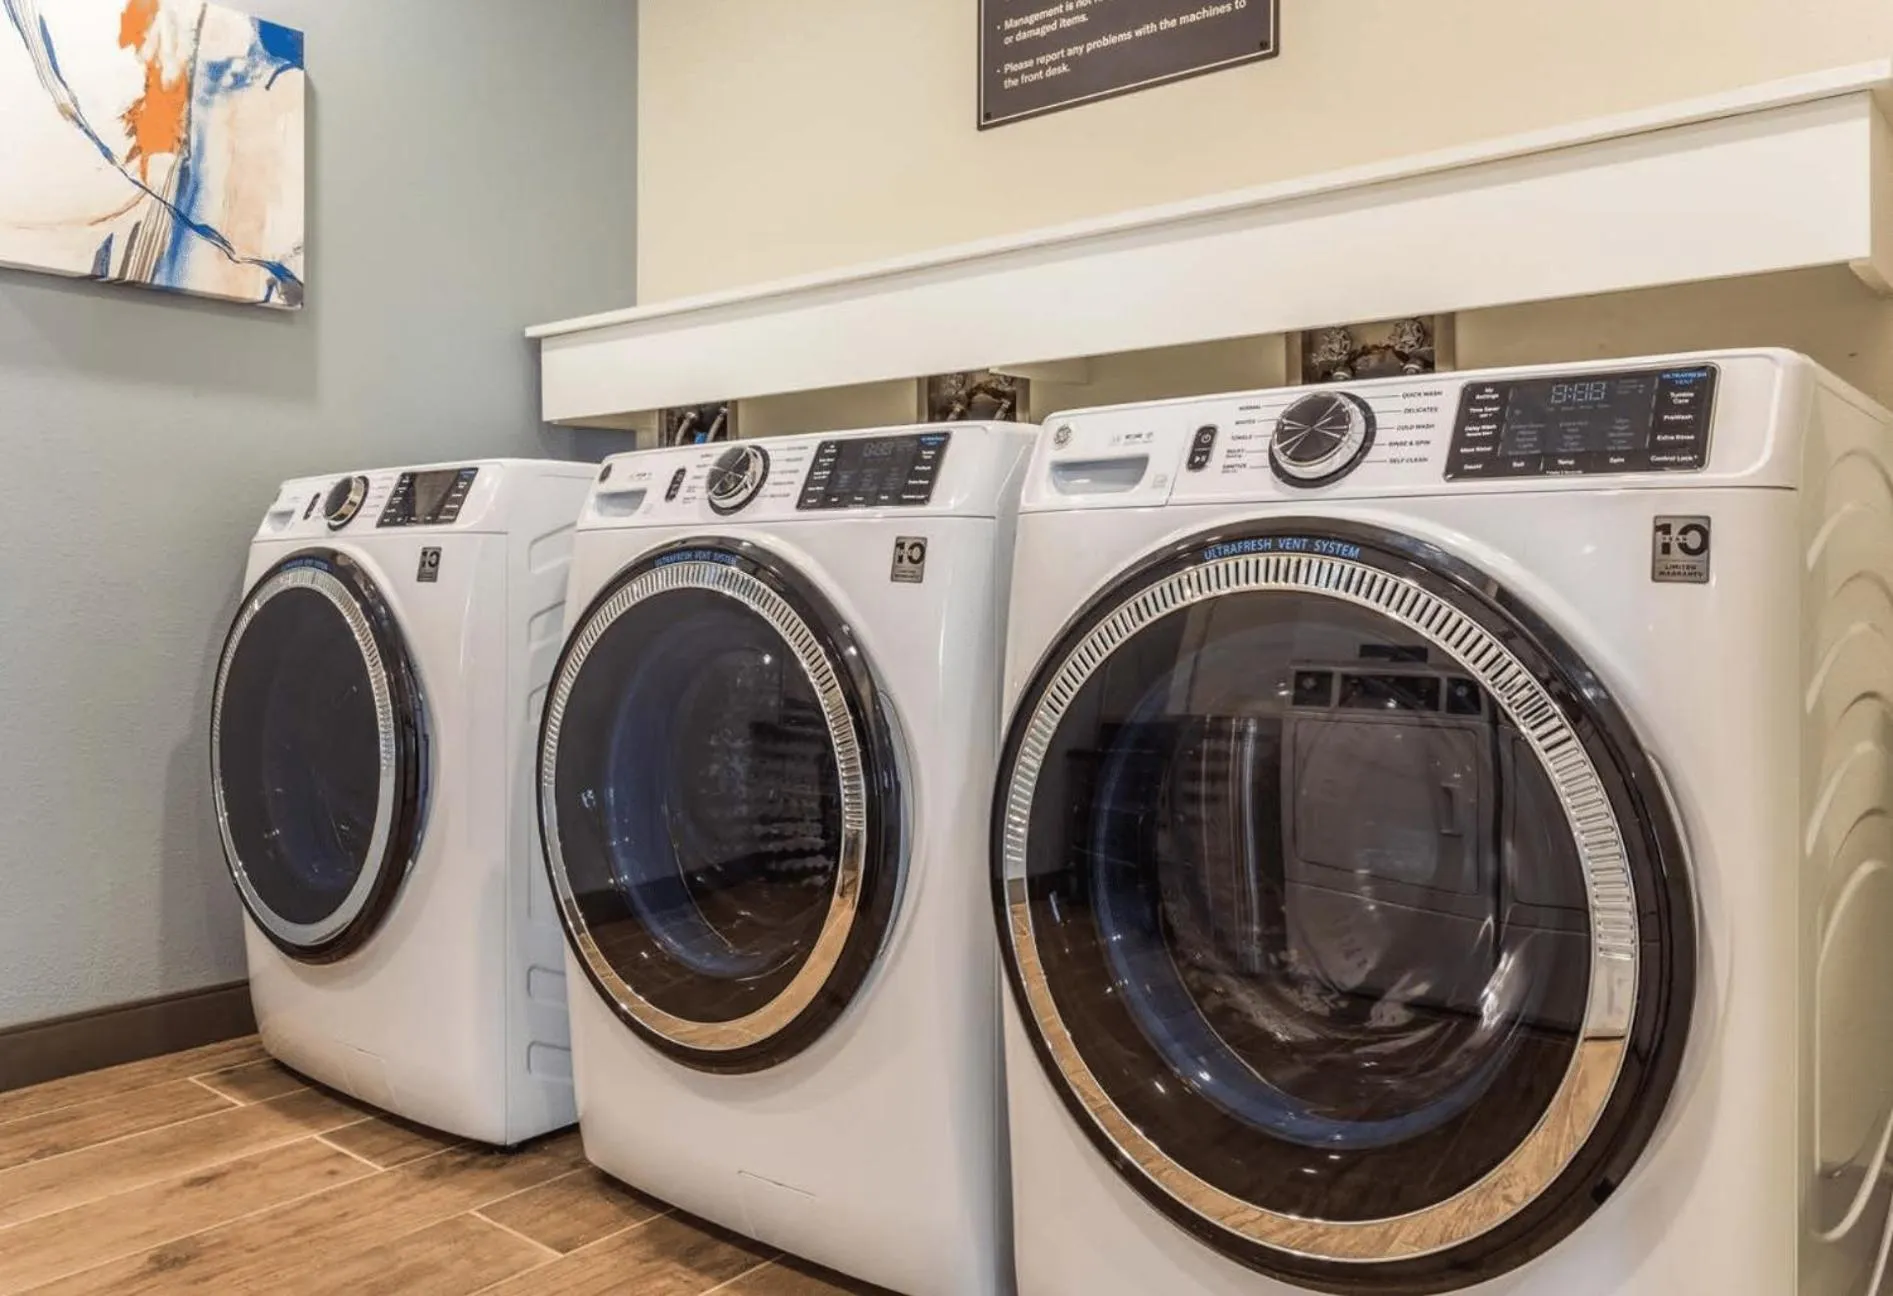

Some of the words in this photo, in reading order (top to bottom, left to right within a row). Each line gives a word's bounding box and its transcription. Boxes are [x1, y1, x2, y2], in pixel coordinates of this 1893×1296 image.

[1004, 4, 1064, 30] Management
[1065, 1, 1074, 11] is
[1004, 34, 1014, 45] or
[1015, 20, 1057, 41] damaged
[1059, 13, 1089, 28] items.
[1003, 59, 1034, 73] Please
[1036, 49, 1065, 65] report
[1066, 43, 1085, 57] any
[1086, 30, 1133, 53] problems
[1135, 22, 1158, 37] with
[1159, 17, 1177, 31] the
[1179, 2, 1232, 25] machines
[1234, 0, 1247, 10] to
[1003, 78, 1019, 89] the
[1020, 70, 1044, 84] front
[1045, 62, 1071, 78] desk.
[896, 542, 926, 564] 10
[1203, 539, 1272, 561] ULTRAFRESH
[1278, 537, 1307, 550] VENT
[1313, 539, 1361, 559] SYSTEM
[1655, 523, 1709, 556] 10
